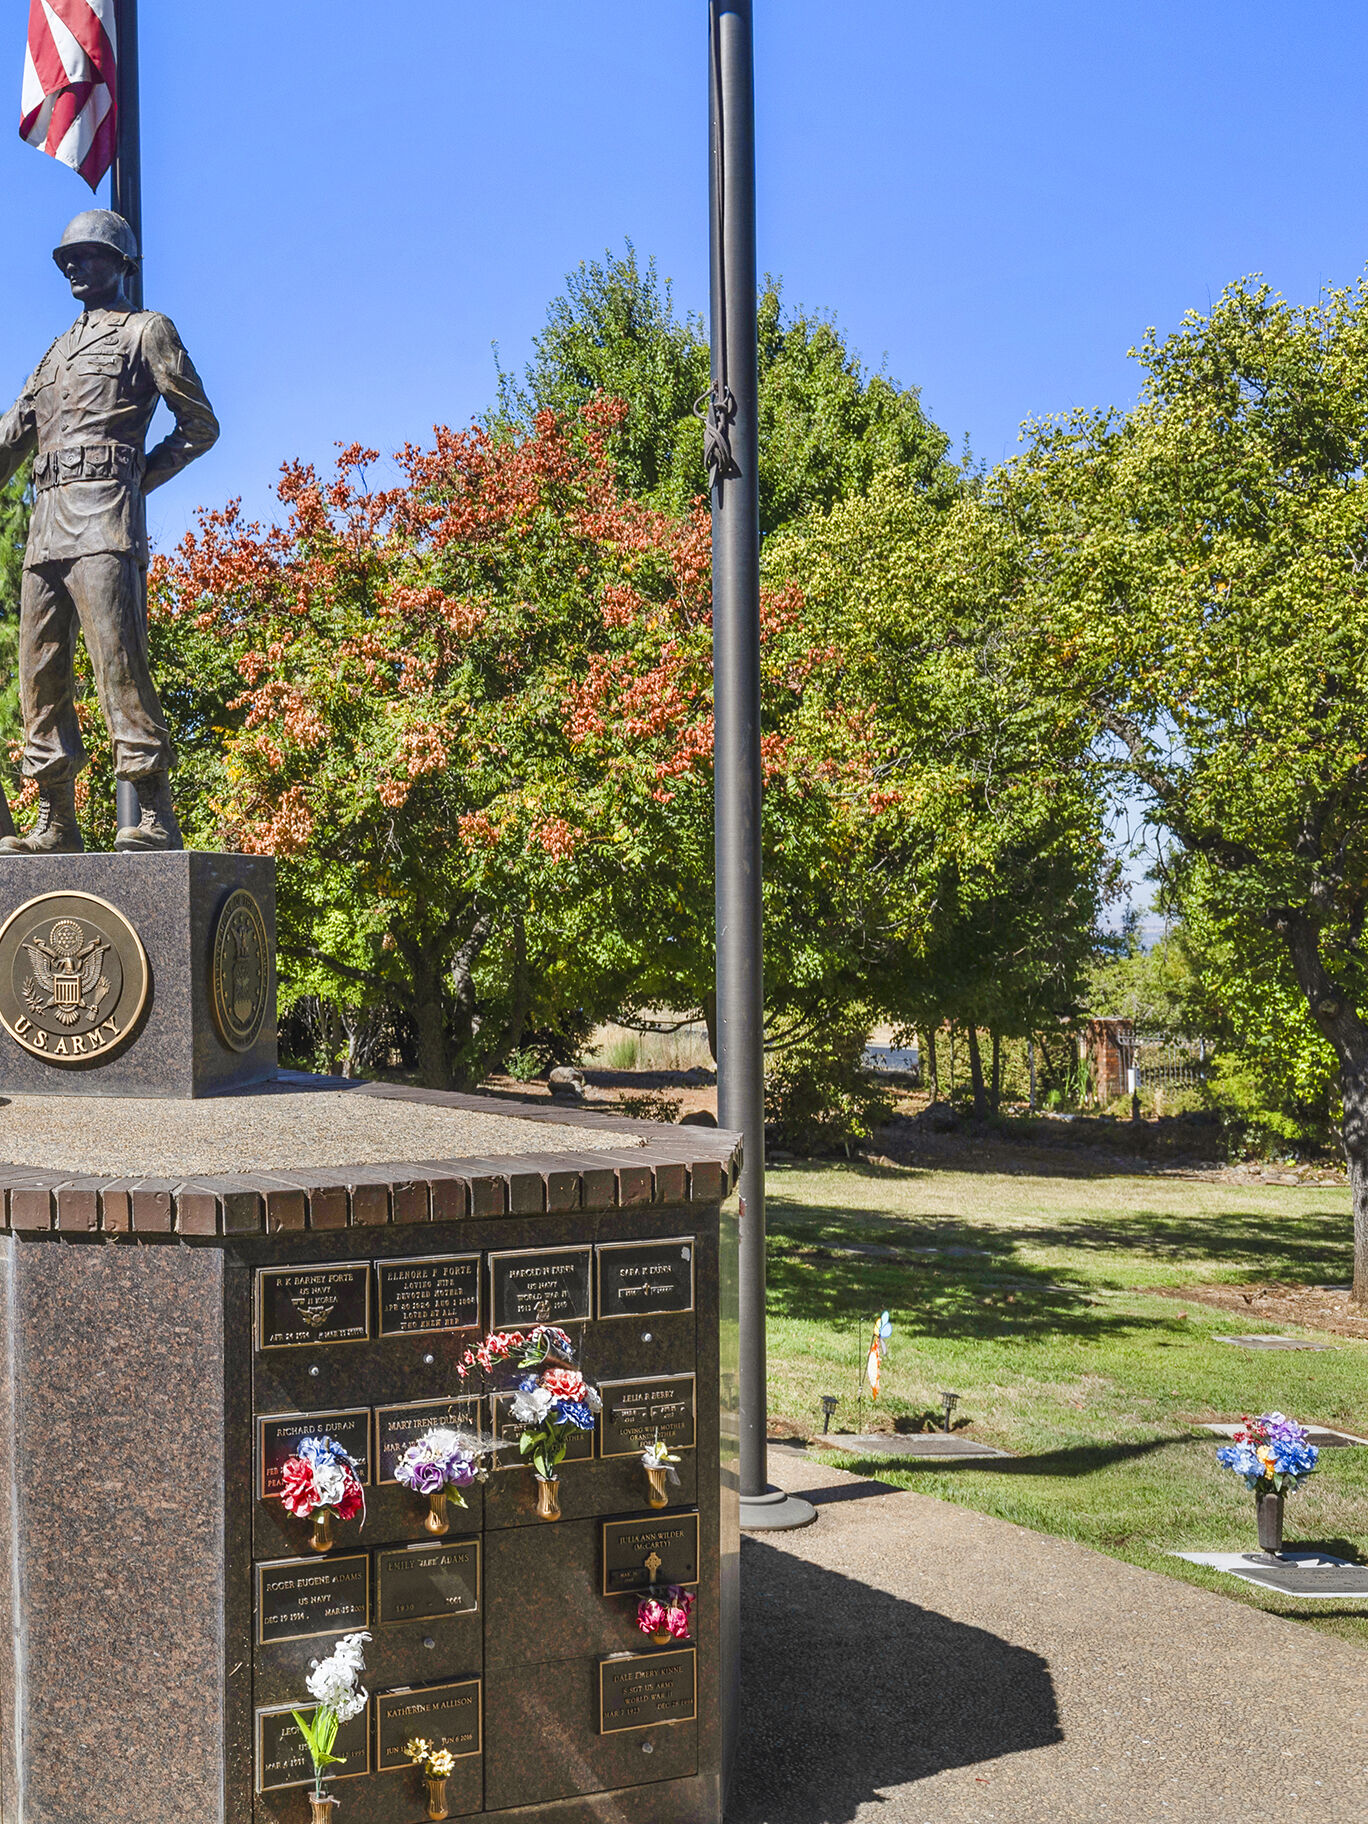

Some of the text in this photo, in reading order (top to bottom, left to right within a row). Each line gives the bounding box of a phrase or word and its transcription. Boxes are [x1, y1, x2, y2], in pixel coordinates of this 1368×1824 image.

[15, 1015, 121, 1054] U.S. ARMY
[388, 1266, 471, 1280] ELENORE FORTE
[509, 1268, 541, 1278] HAROLD
[295, 1276, 325, 1284] BARNEY
[329, 1274, 353, 1282] FORTE
[404, 1281, 431, 1289] LOVING
[397, 1288, 463, 1300] DEVOTED MOTHER
[403, 1311, 427, 1319] LOVED
[421, 1319, 441, 1327] KNEW
[652, 1391, 674, 1399] BERRY
[388, 1414, 469, 1431] MARY IRENE DURAN
[660, 1422, 685, 1430] MOTHER
[277, 1426, 315, 1436] RICHARD
[326, 1422, 355, 1431] DURAN
[384, 1444, 400, 1452] MAR
[620, 1536, 639, 1544] JULIA
[658, 1530, 684, 1539] WILDER
[388, 1561, 415, 1571] EMILY
[441, 1554, 469, 1564] ADAMS
[267, 1573, 361, 1591] ROGER EUGENE ADAMS
[311, 1595, 331, 1603] NAVY
[265, 1616, 278, 1624] DEC
[325, 1608, 340, 1616] MAR
[614, 1673, 632, 1682] DALE
[635, 1669, 658, 1679] EMERY
[625, 1696, 648, 1704] WORLD
[387, 1705, 430, 1718] KATHERINE
[441, 1697, 472, 1708] ALLISON
[387, 1747, 399, 1755] JUN
